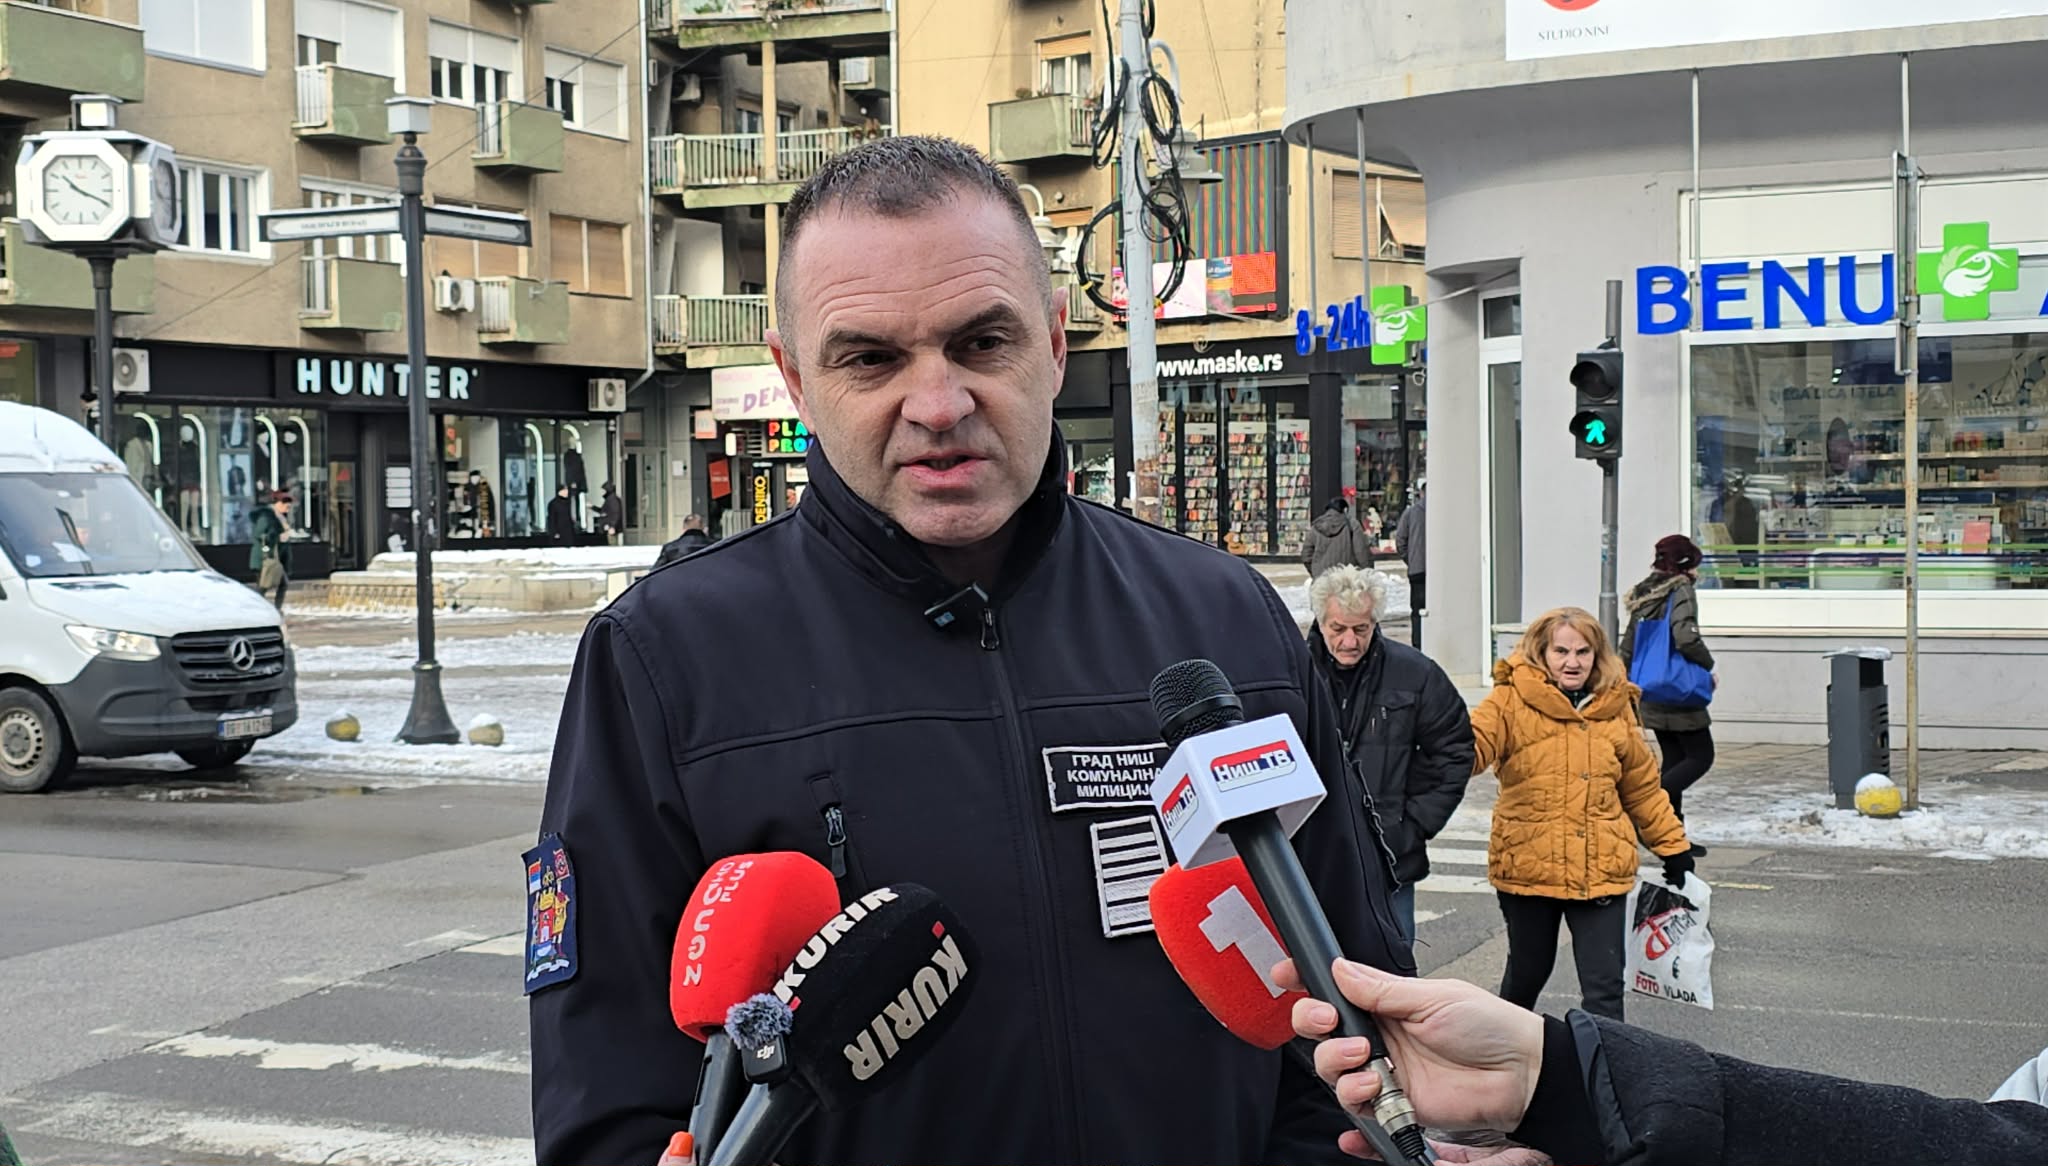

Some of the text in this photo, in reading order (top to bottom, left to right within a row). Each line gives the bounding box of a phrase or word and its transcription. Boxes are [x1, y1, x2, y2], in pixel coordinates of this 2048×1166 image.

[1538, 27, 1582, 41] STUDIO
[1636, 253, 1895, 336] BENU
[1296, 294, 1371, 356] 8-24h
[297, 357, 469, 400] HUNTER
[1813, 387, 1846, 400] LICA
[1857, 386, 1897, 399] TELA
[768, 438, 814, 453] PRO
[754, 475, 767, 524] DENIKO
[1071, 751, 1155, 770] ГРАД НИШ
[1213, 749, 1293, 785] Ниш ТВ
[773, 887, 900, 1004] KURIR
[1198, 884, 1288, 999] 1
[843, 933, 969, 1081] KURIR
[1635, 974, 1698, 1004] FOTO VLADA
